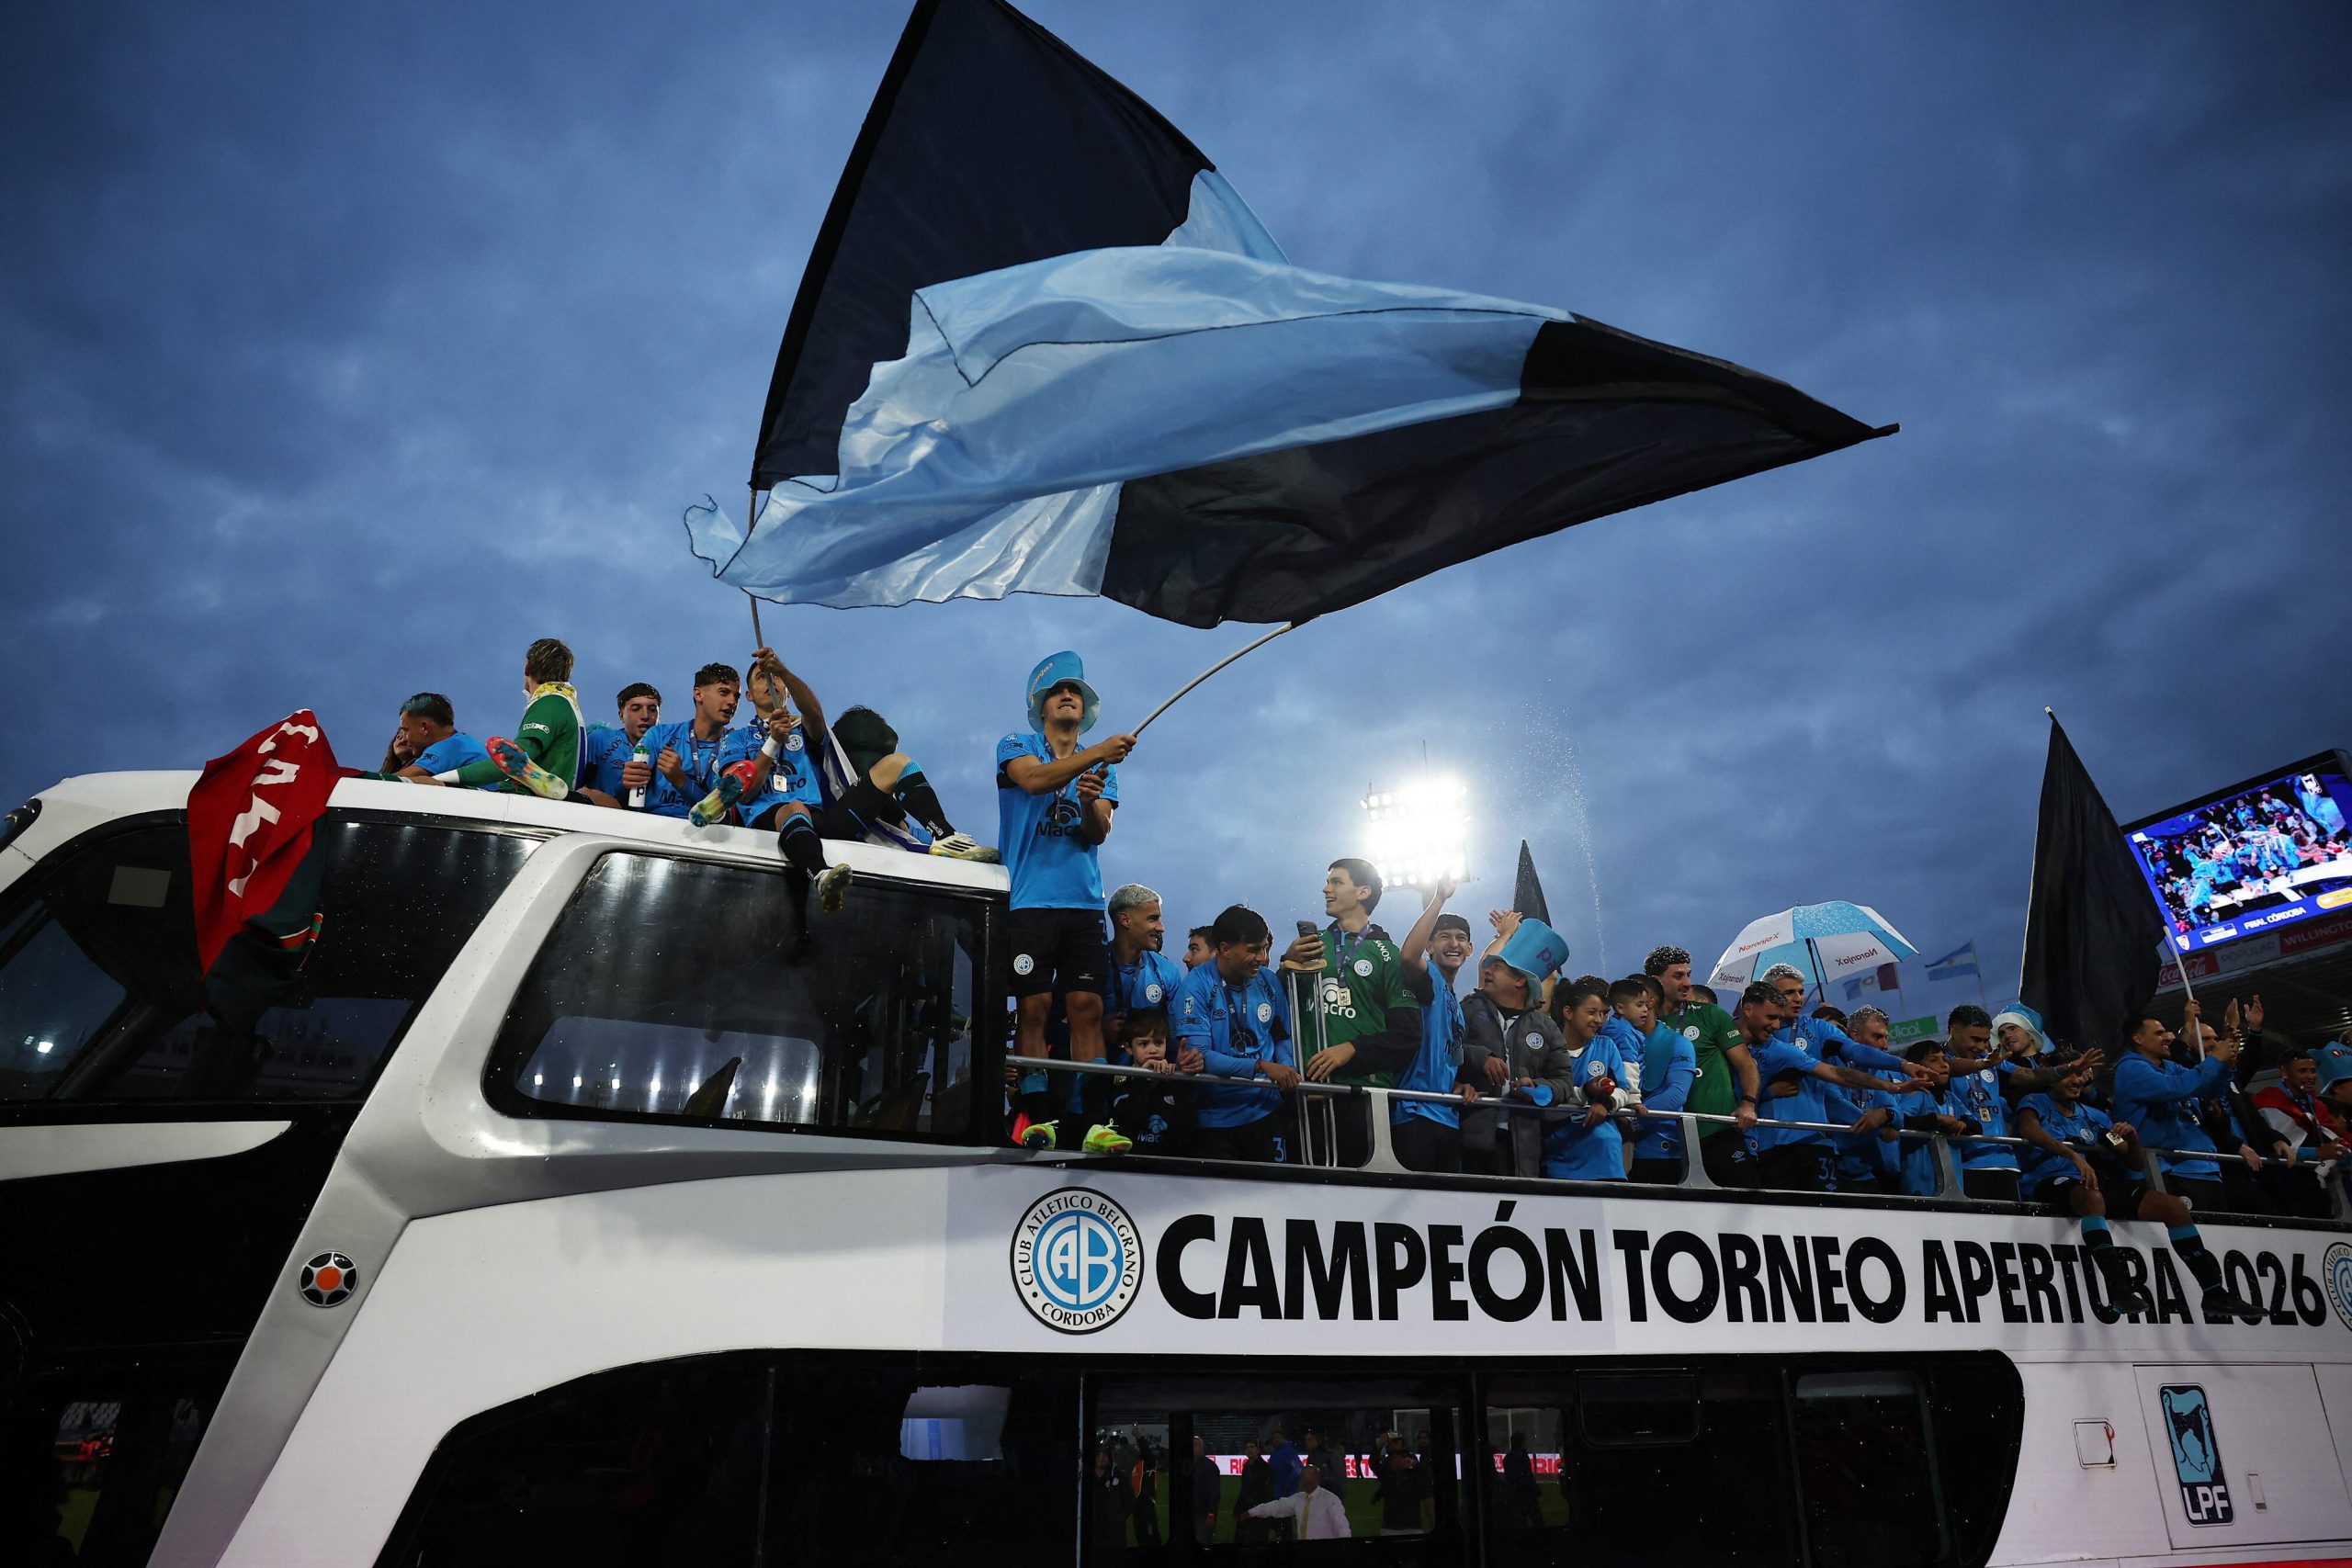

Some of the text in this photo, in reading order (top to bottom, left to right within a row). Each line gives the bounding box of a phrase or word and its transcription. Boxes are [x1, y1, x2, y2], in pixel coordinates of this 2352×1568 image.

[600, 737, 622, 762] SANOS
[1035, 821, 1079, 838] Mac
[2221, 941, 2276, 964] POPULAR
[2159, 956, 2207, 987] CocaCola
[1817, 1156, 1837, 1180] 32
[1018, 1195, 1137, 1288] CLUB ATLETICO BELGRANO
[1156, 1200, 1602, 1323] CAMPEÓN
[1614, 1230, 1906, 1324] TORNEO
[1922, 1239, 2195, 1325] APERTURA
[1041, 1302, 1116, 1326] CORDOBA
[2183, 1485, 2229, 1521] LPF
